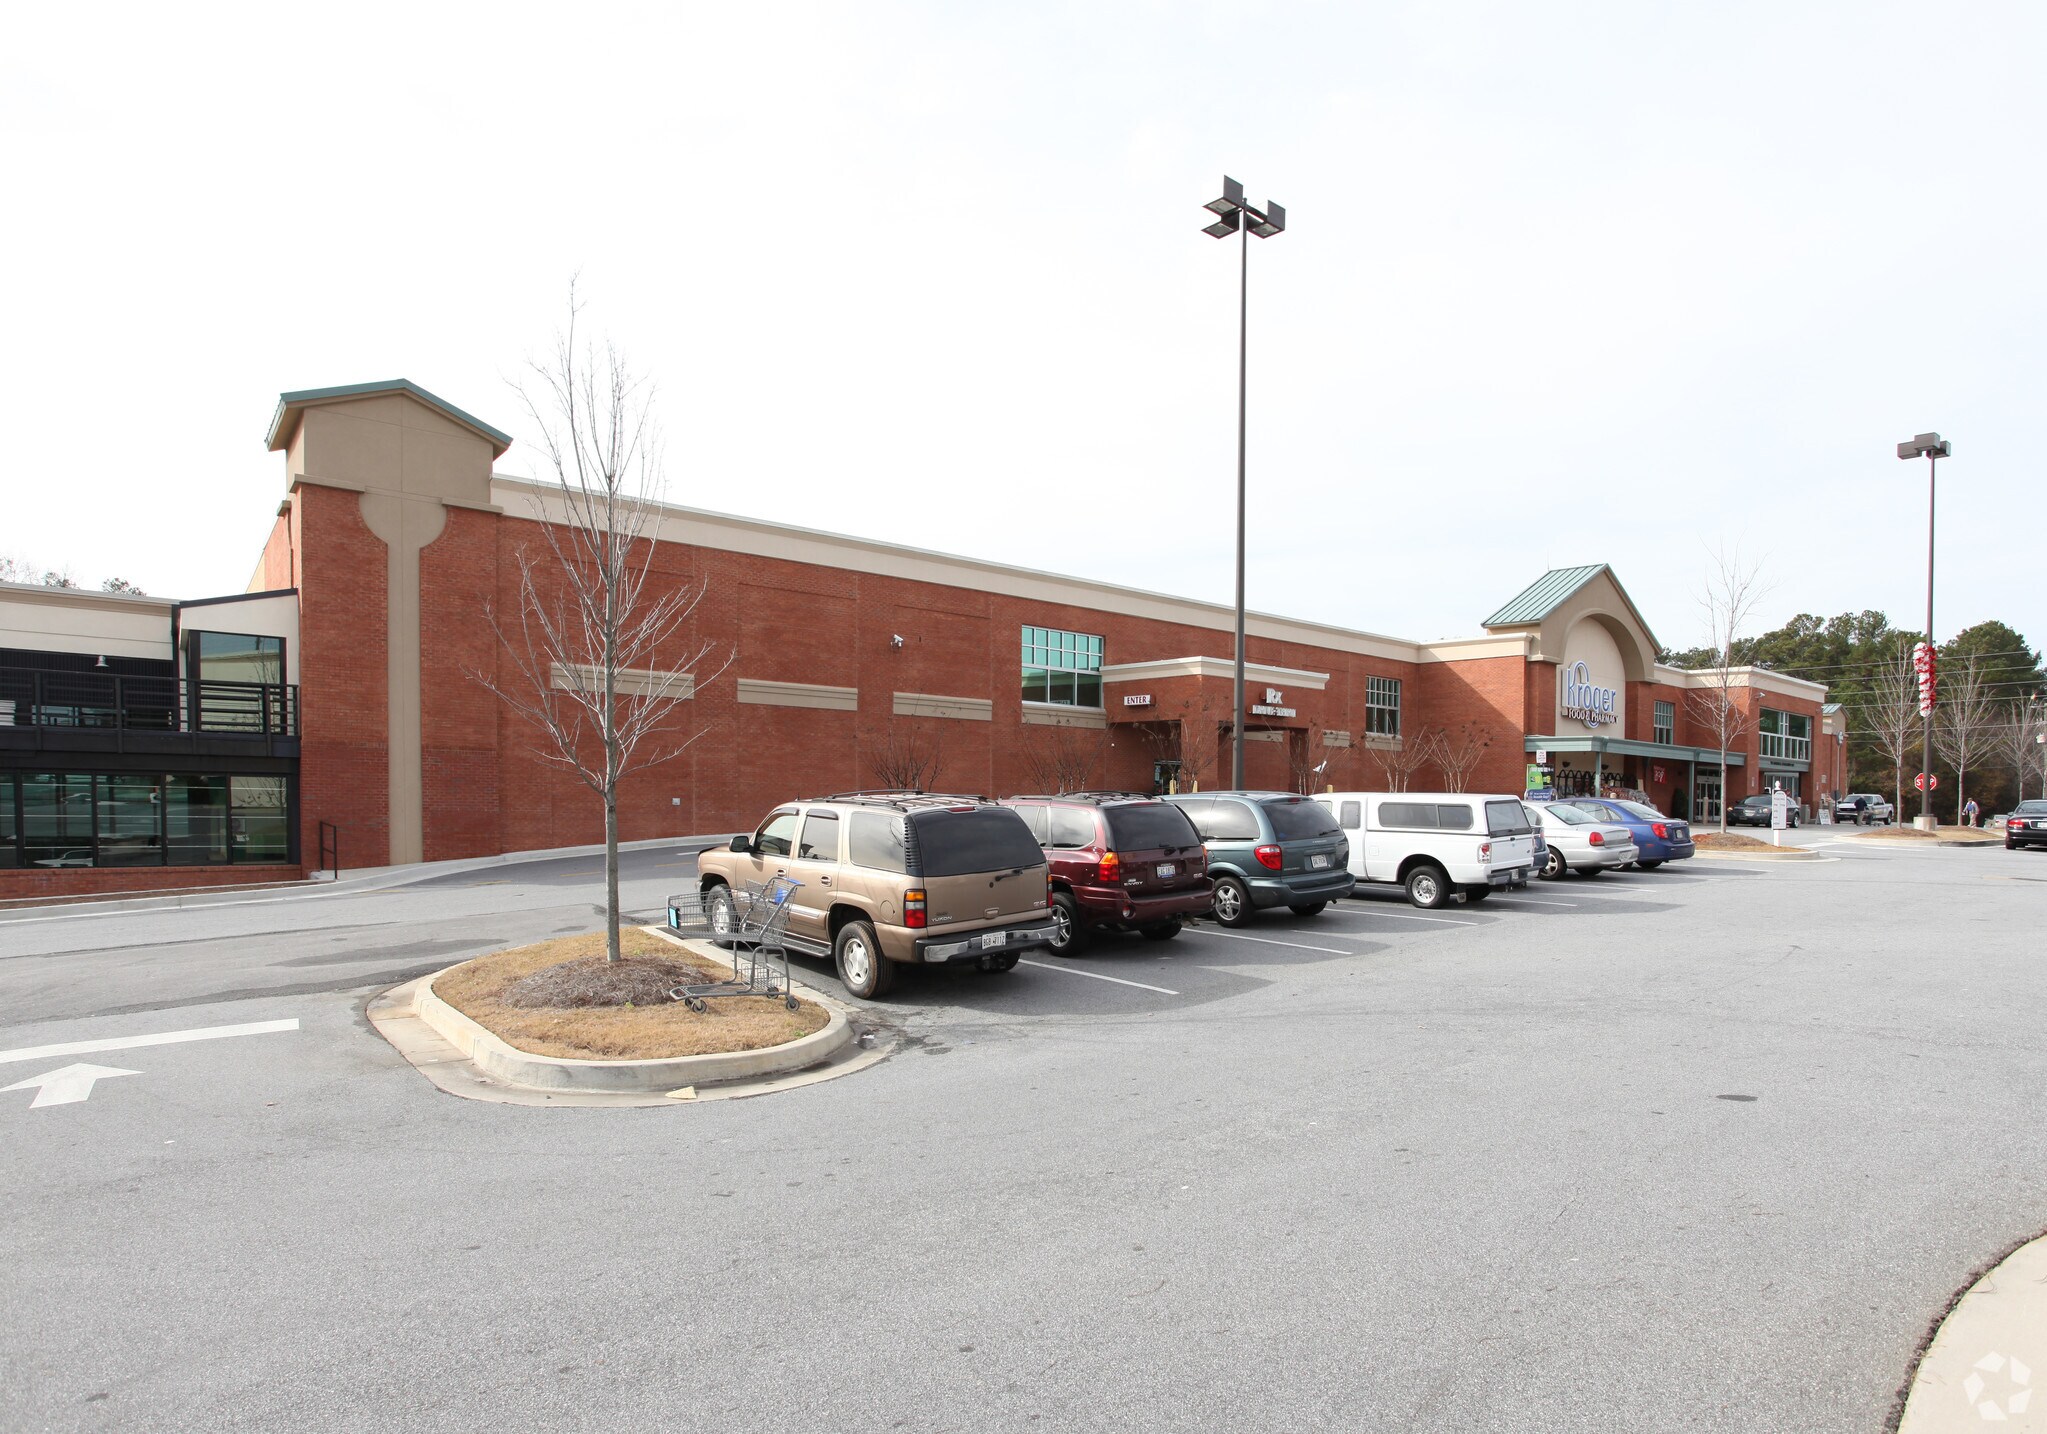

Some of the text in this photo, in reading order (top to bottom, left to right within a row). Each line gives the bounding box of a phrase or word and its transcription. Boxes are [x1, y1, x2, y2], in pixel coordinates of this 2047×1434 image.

[1567, 660, 1616, 728] Kroger
[1127, 695, 1147, 704] ENTER
[1568, 708, 1585, 720] FOOD
[1916, 778, 1935, 786] STP
